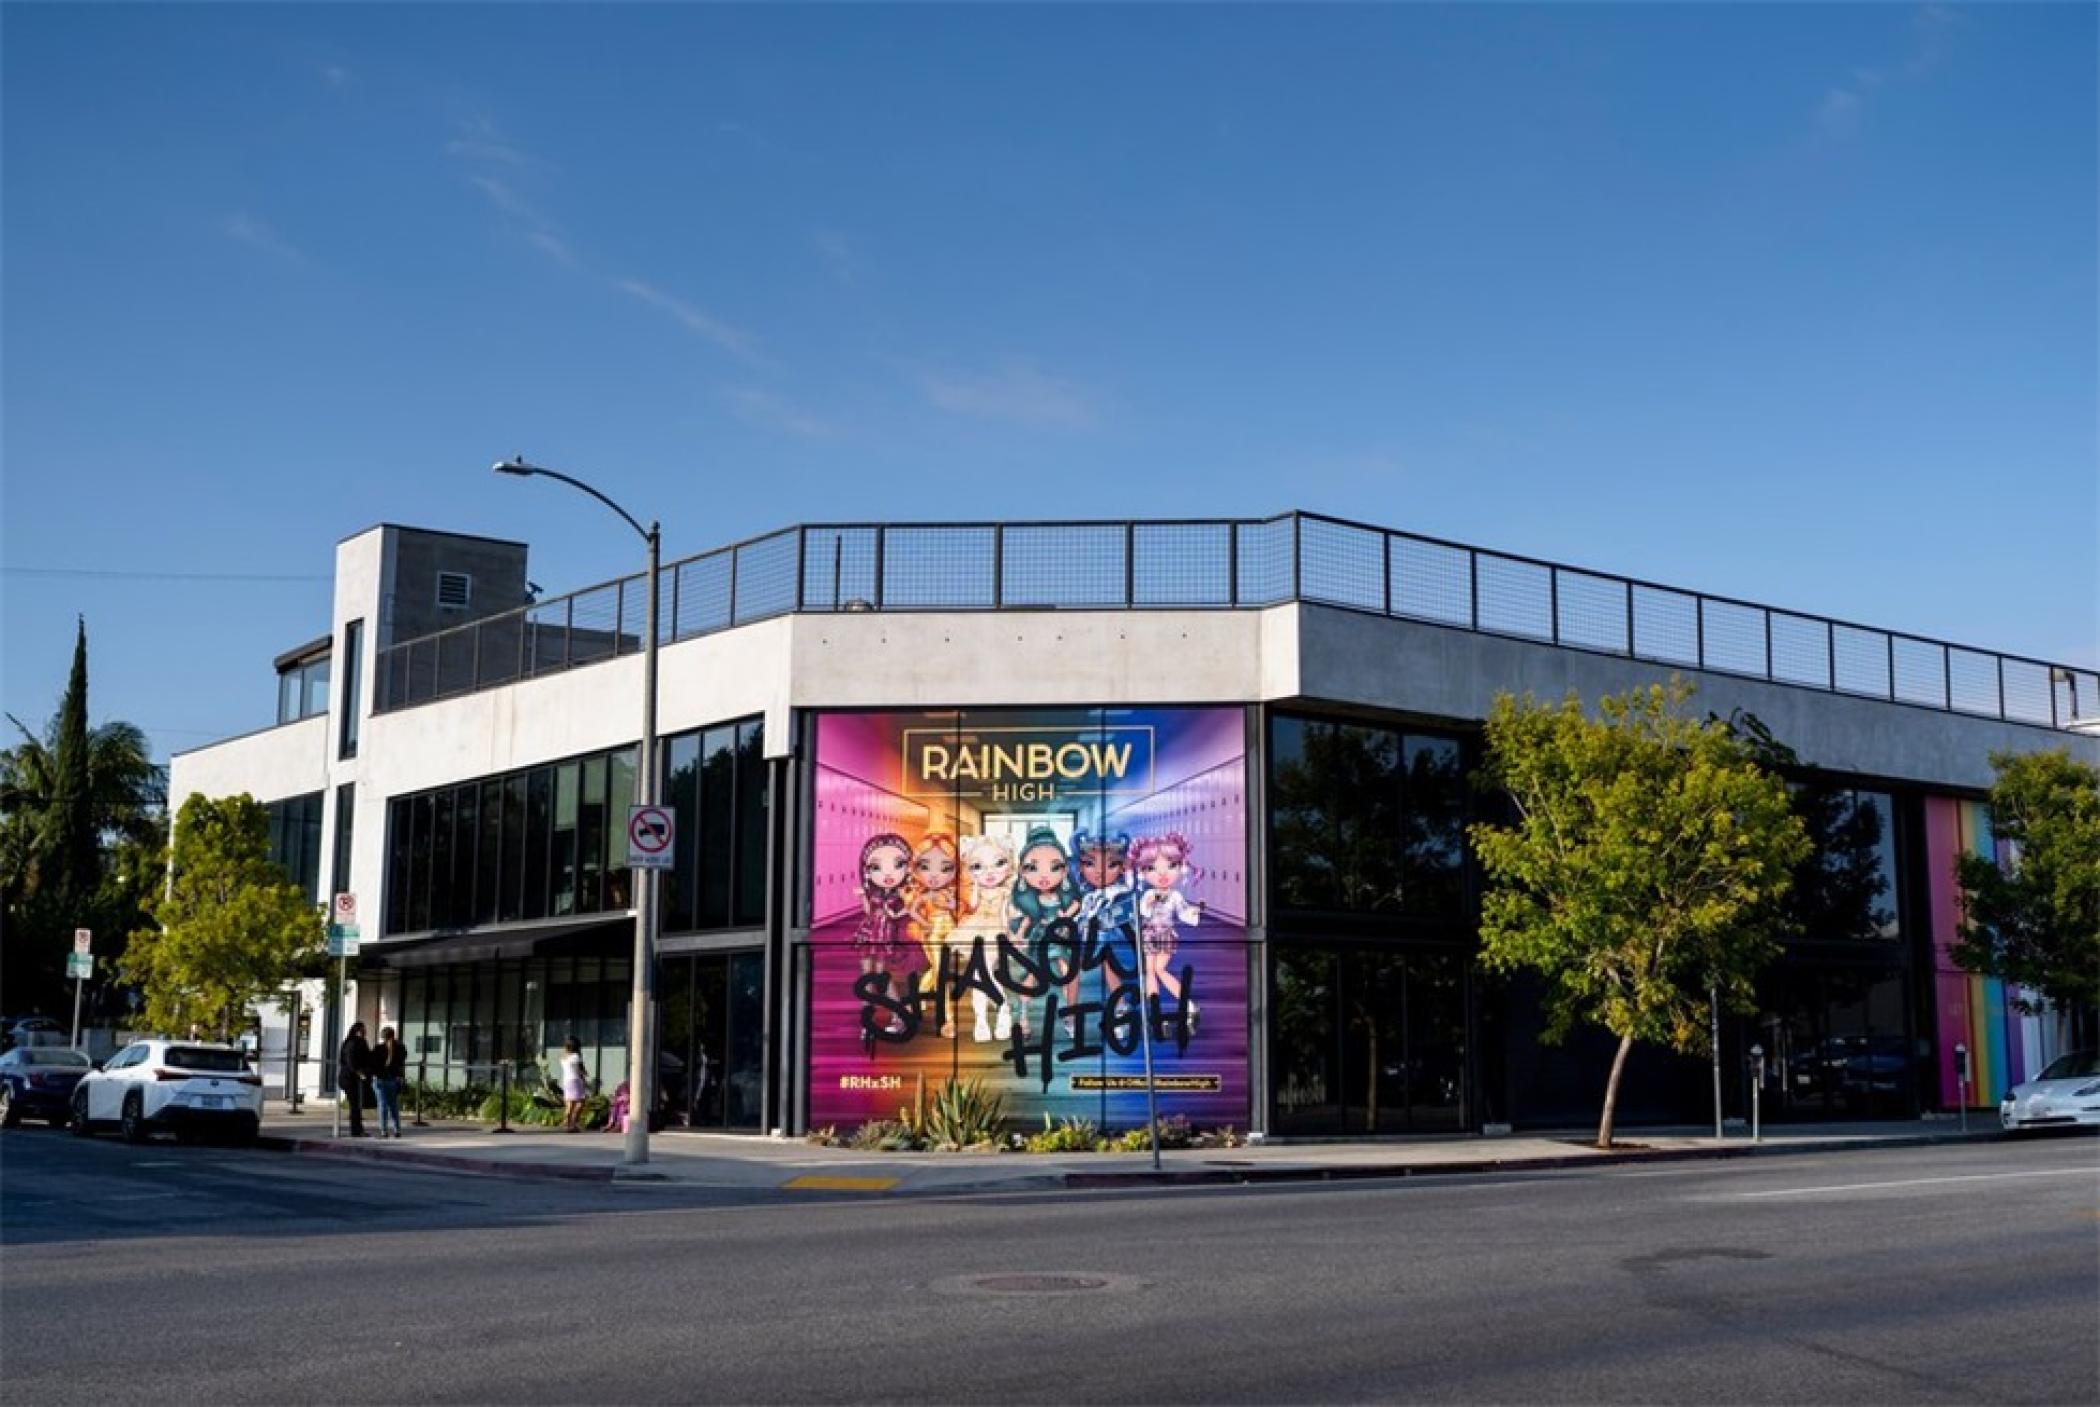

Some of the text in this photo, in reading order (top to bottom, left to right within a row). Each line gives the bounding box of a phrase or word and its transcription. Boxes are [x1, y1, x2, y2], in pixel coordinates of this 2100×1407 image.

[922, 743, 1132, 780] RAINBOW
[993, 783, 1055, 802] HIGH
[854, 917, 1138, 1055] SHADOW
[1002, 965, 1194, 1092] HIGH
